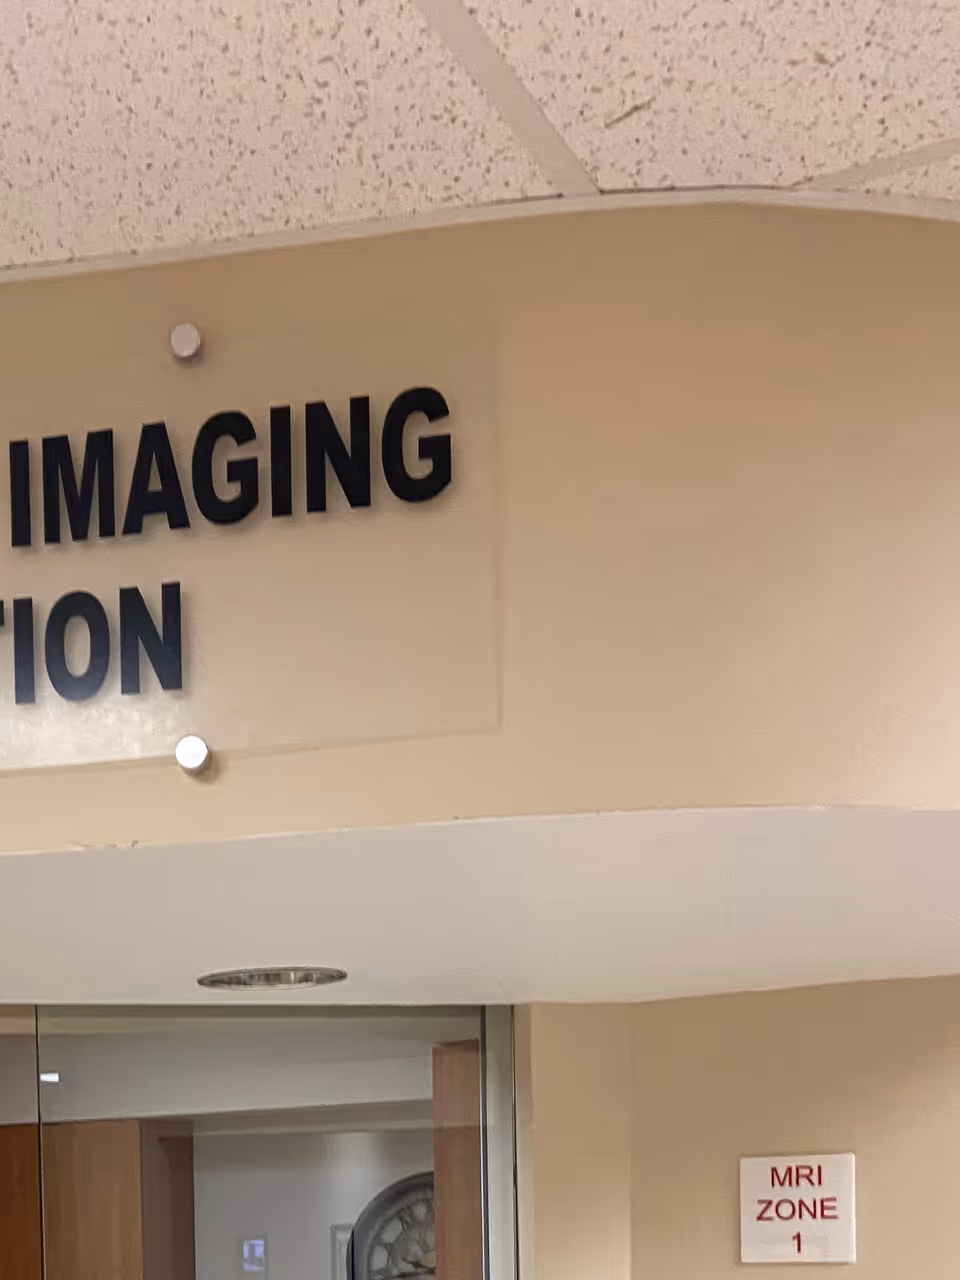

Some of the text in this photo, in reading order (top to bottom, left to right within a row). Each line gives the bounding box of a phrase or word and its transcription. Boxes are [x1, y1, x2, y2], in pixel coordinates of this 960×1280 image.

[8, 386, 453, 548] IMAGING
[770, 1164, 823, 1188] MRI
[756, 1197, 839, 1221] ZONE
[791, 1231, 802, 1253] 1
